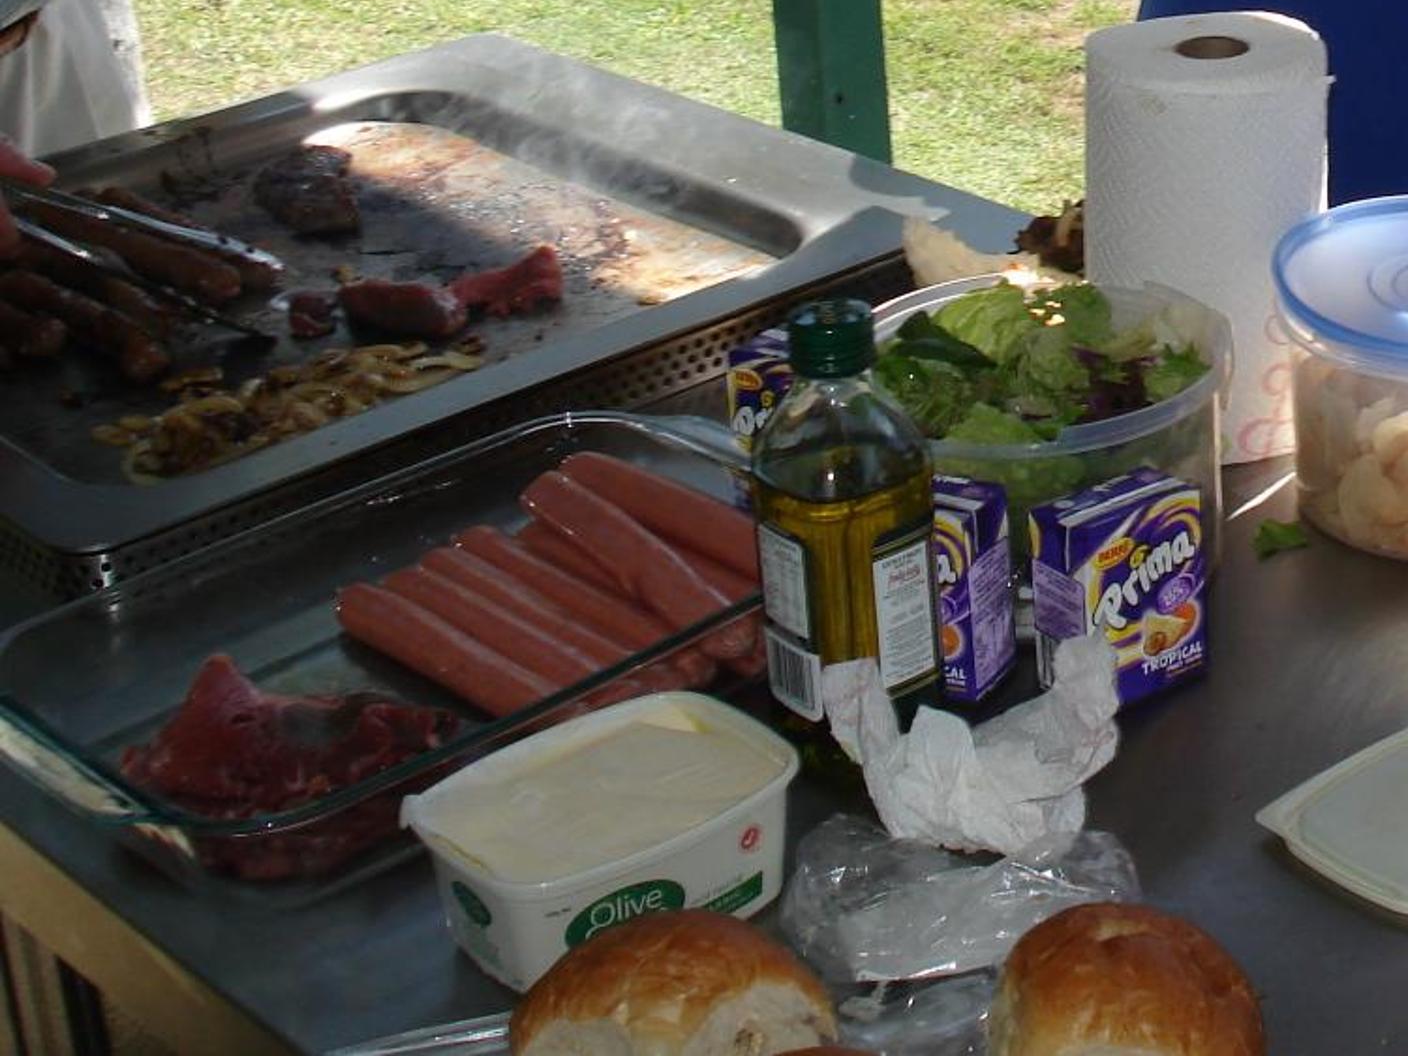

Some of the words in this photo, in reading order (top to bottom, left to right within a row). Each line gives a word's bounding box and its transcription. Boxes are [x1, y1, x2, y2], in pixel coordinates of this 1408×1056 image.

[1093, 531, 1195, 629] Prima
[1141, 641, 1202, 676] TROPICAL
[586, 889, 663, 929] Olive
